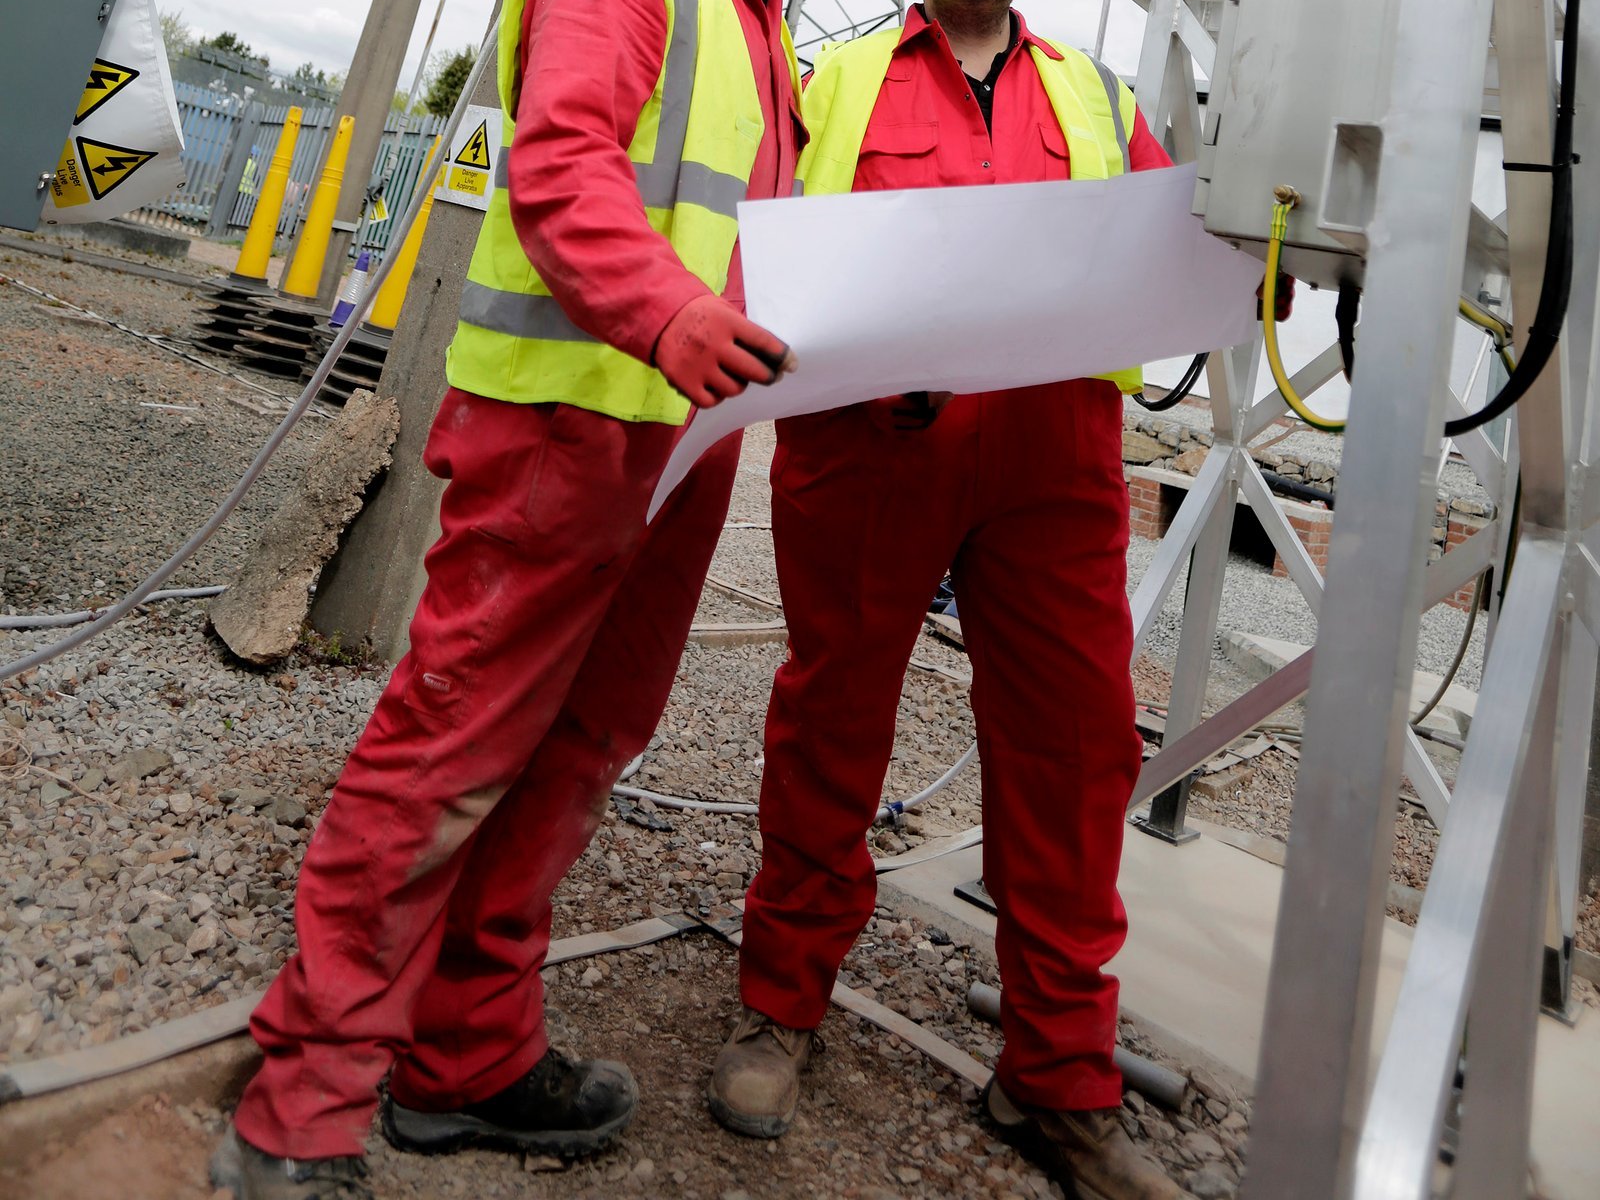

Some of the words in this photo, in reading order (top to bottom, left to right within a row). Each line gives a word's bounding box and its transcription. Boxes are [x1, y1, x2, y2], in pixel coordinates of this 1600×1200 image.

[57, 169, 68, 185] Live
[66, 159, 81, 187] Danger
[461, 169, 479, 178] Danger
[464, 177, 474, 185] Live
[51, 179, 63, 197] ratus
